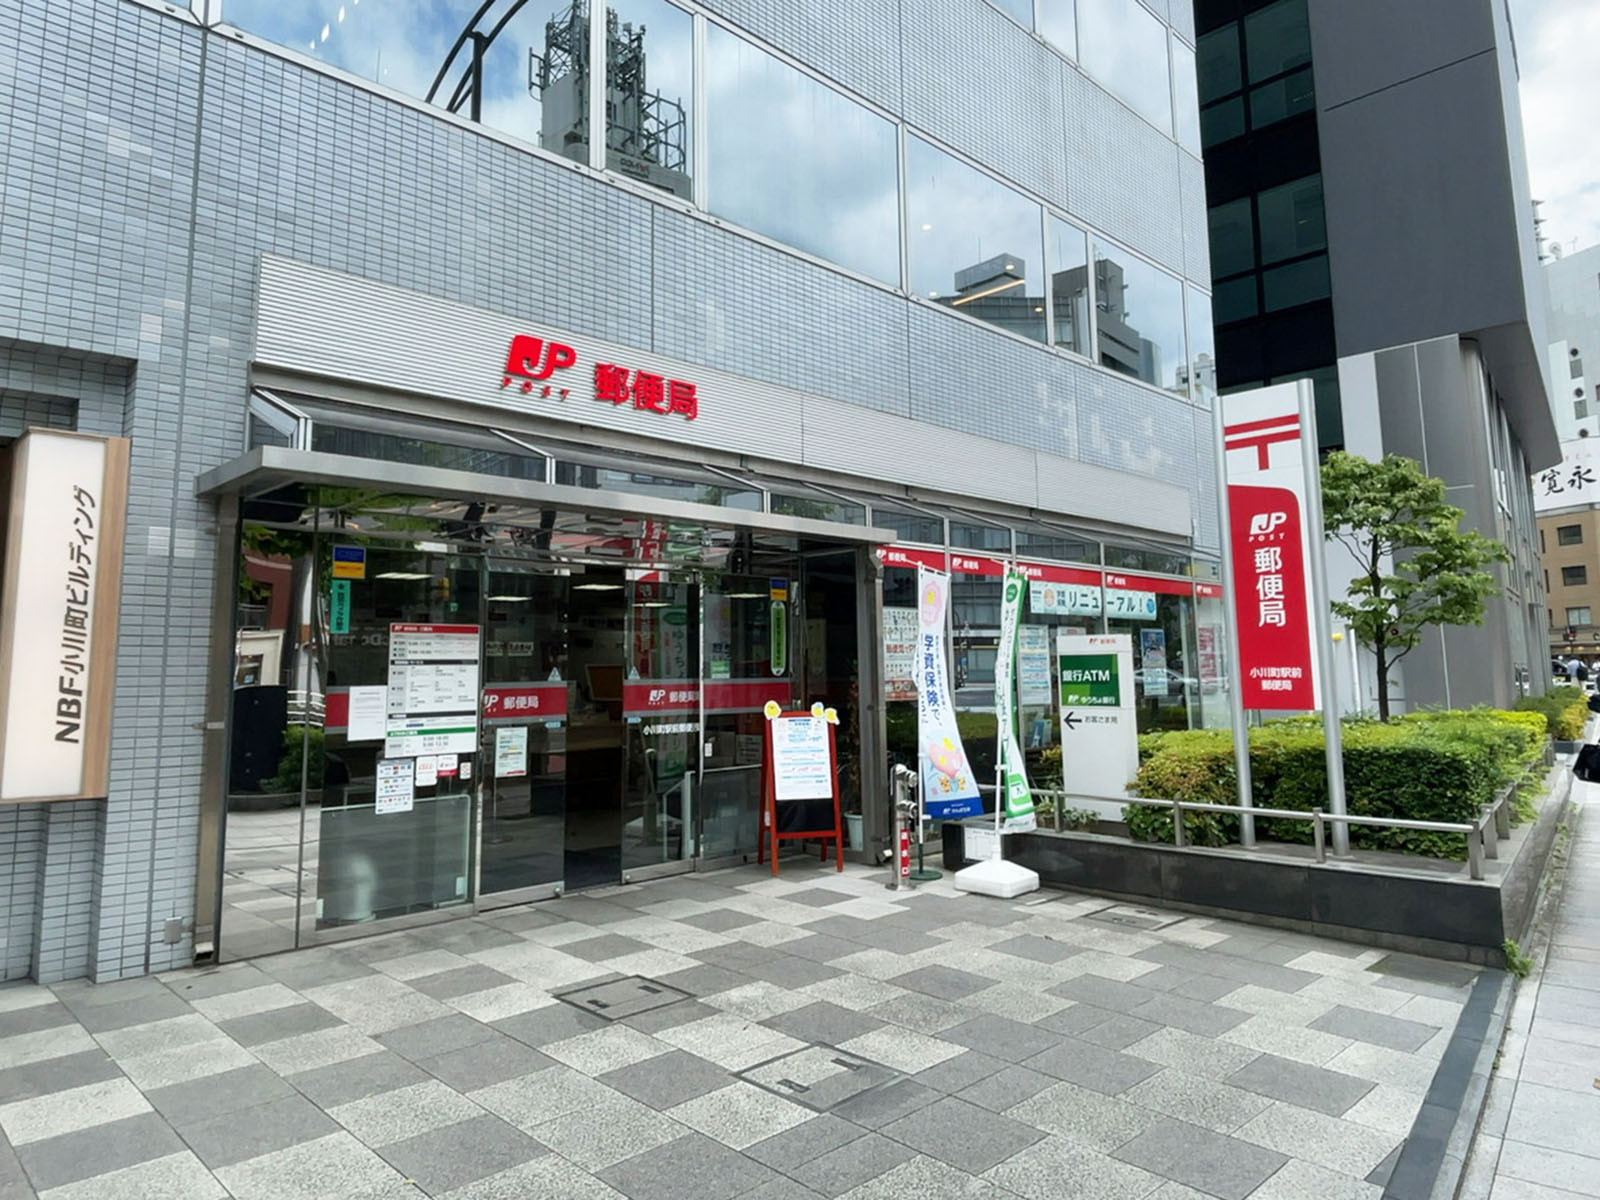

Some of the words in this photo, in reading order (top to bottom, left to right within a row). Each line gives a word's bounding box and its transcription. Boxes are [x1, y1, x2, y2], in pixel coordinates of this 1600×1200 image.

[506, 334, 577, 380] JP
[594, 362, 698, 421] 郵便局
[501, 376, 571, 401] POST
[1249, 511, 1287, 535] JP
[1248, 533, 1285, 542] POST
[1254, 546, 1286, 628] 郵便局
[55, 485, 97, 744] NBF小川町ビルディング
[1062, 669, 1110, 682] 銀行ATM
[1249, 666, 1303, 679] 小川町駅前
[1261, 679, 1293, 691] 郵便局
[503, 695, 539, 710] 郵便局
